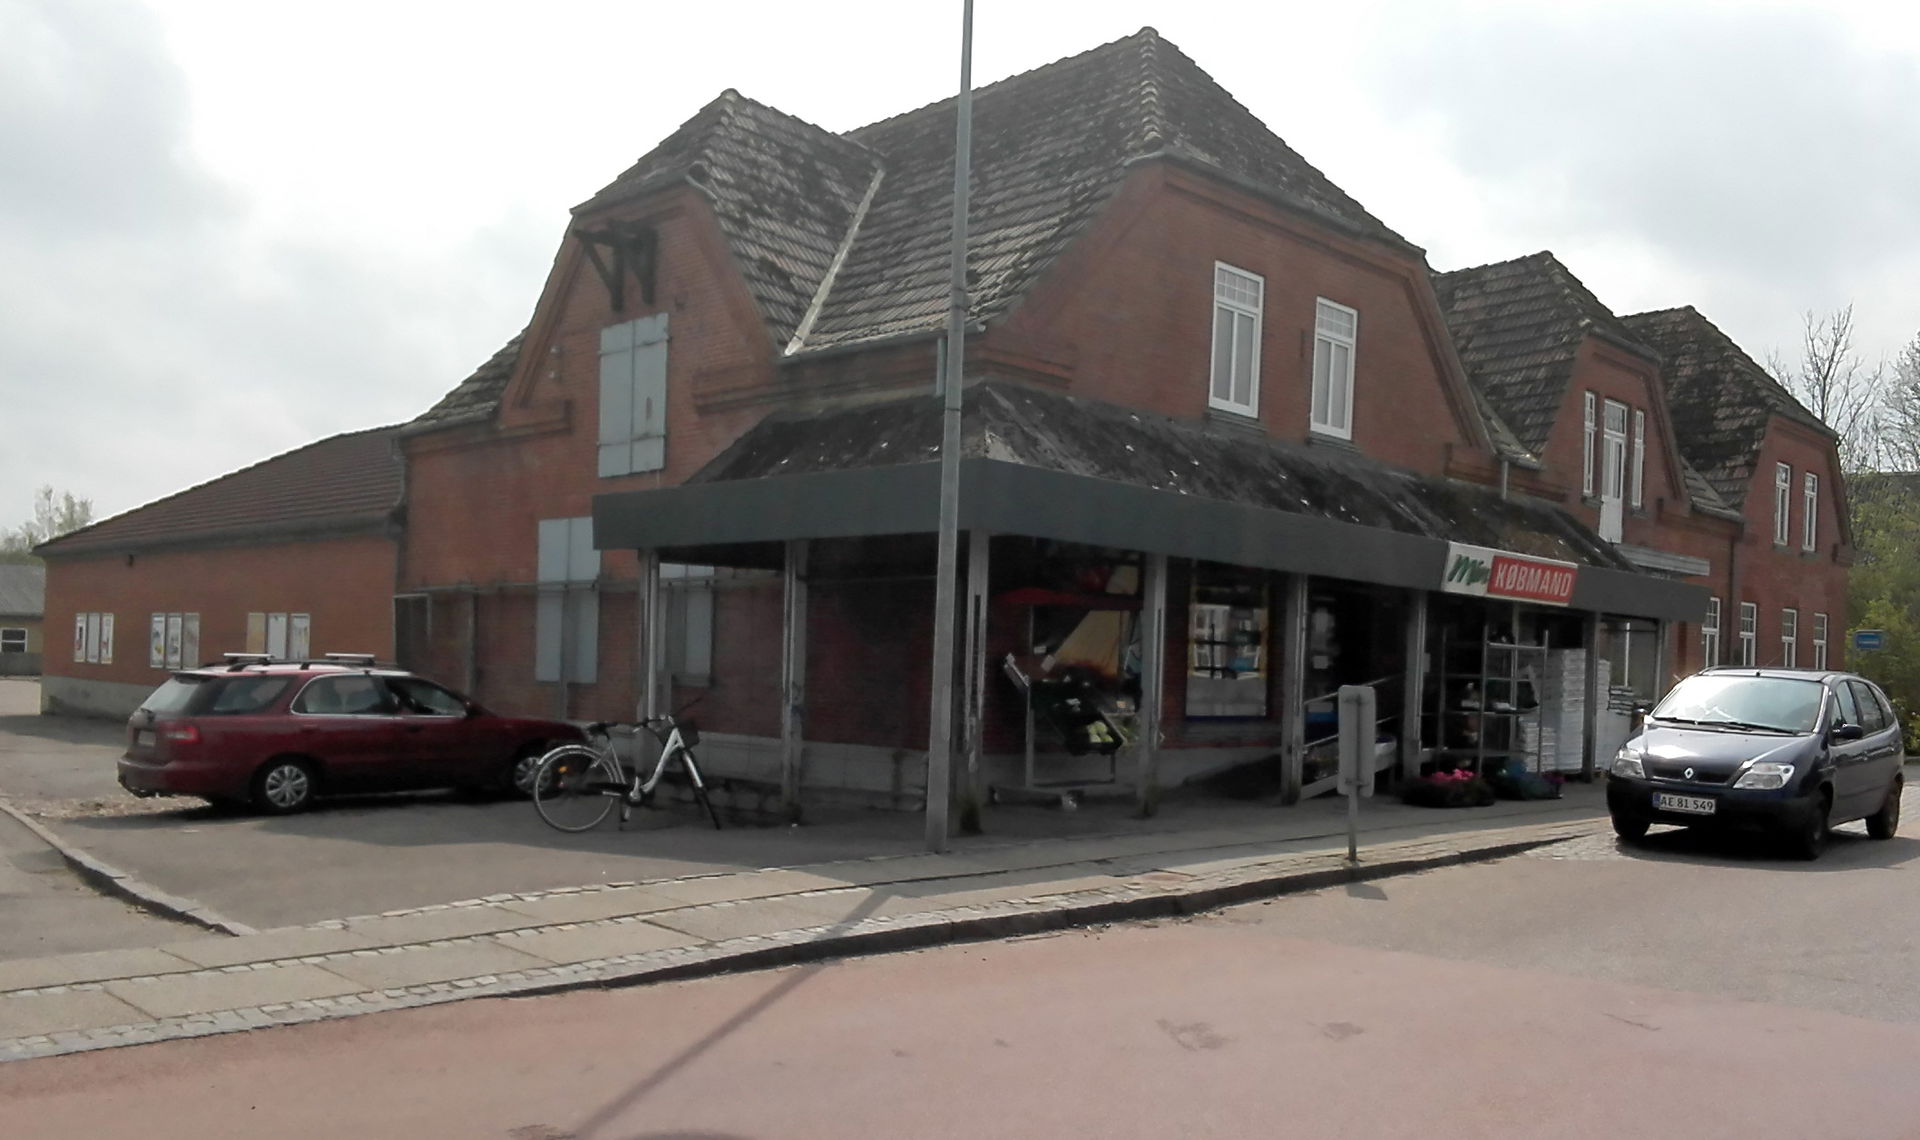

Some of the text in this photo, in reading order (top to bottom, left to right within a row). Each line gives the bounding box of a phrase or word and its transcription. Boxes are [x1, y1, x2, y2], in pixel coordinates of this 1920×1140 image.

[1495, 562, 1573, 597] KØBMAND
[1660, 796, 1714, 811] AE 81 549
